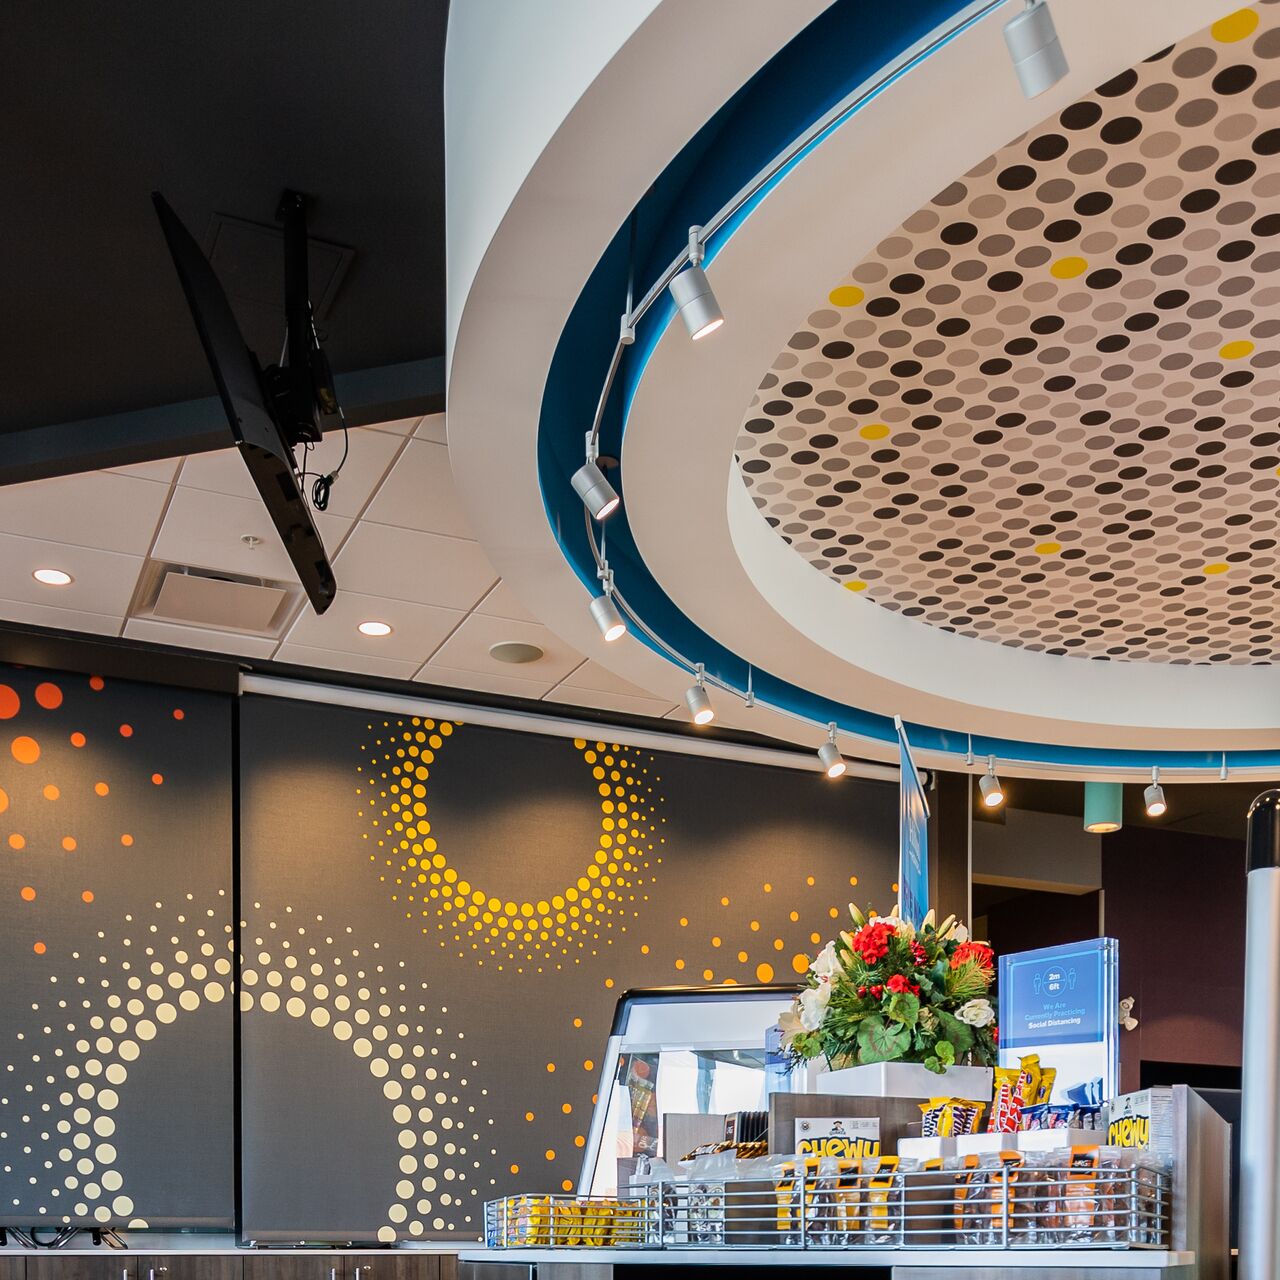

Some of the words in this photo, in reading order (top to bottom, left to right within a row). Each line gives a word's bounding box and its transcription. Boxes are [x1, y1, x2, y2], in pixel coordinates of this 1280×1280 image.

[1048, 973, 1061, 981] 2m
[1049, 983, 1060, 991] 6ft
[1024, 1012, 1052, 1020] Currently
[1053, 1008, 1086, 1017] Practicing
[1028, 1020, 1047, 1030] Social
[1047, 1017, 1081, 1027] Distancing
